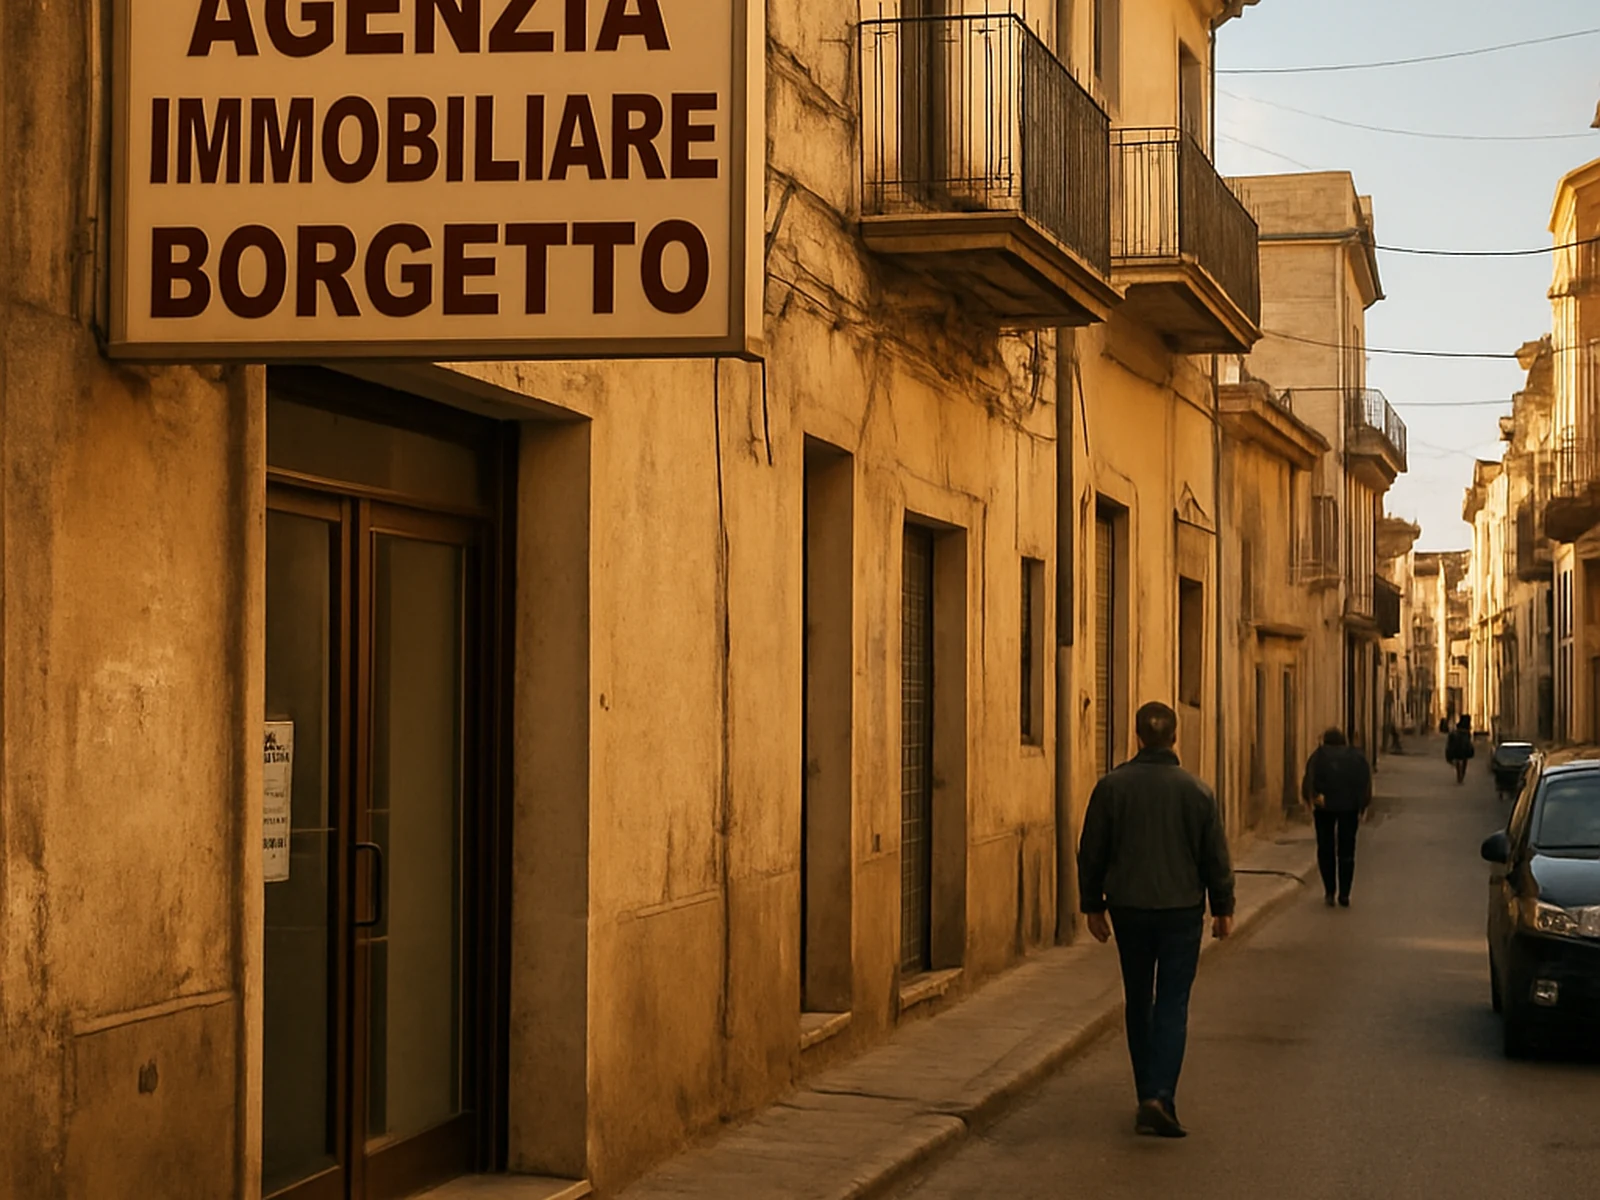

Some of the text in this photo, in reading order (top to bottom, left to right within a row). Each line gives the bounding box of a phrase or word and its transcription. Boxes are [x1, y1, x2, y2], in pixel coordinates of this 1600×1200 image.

[187, 0, 671, 57] AGENZIA
[150, 93, 718, 184] IMMOBILIARE
[150, 220, 709, 320] BORGETTO
